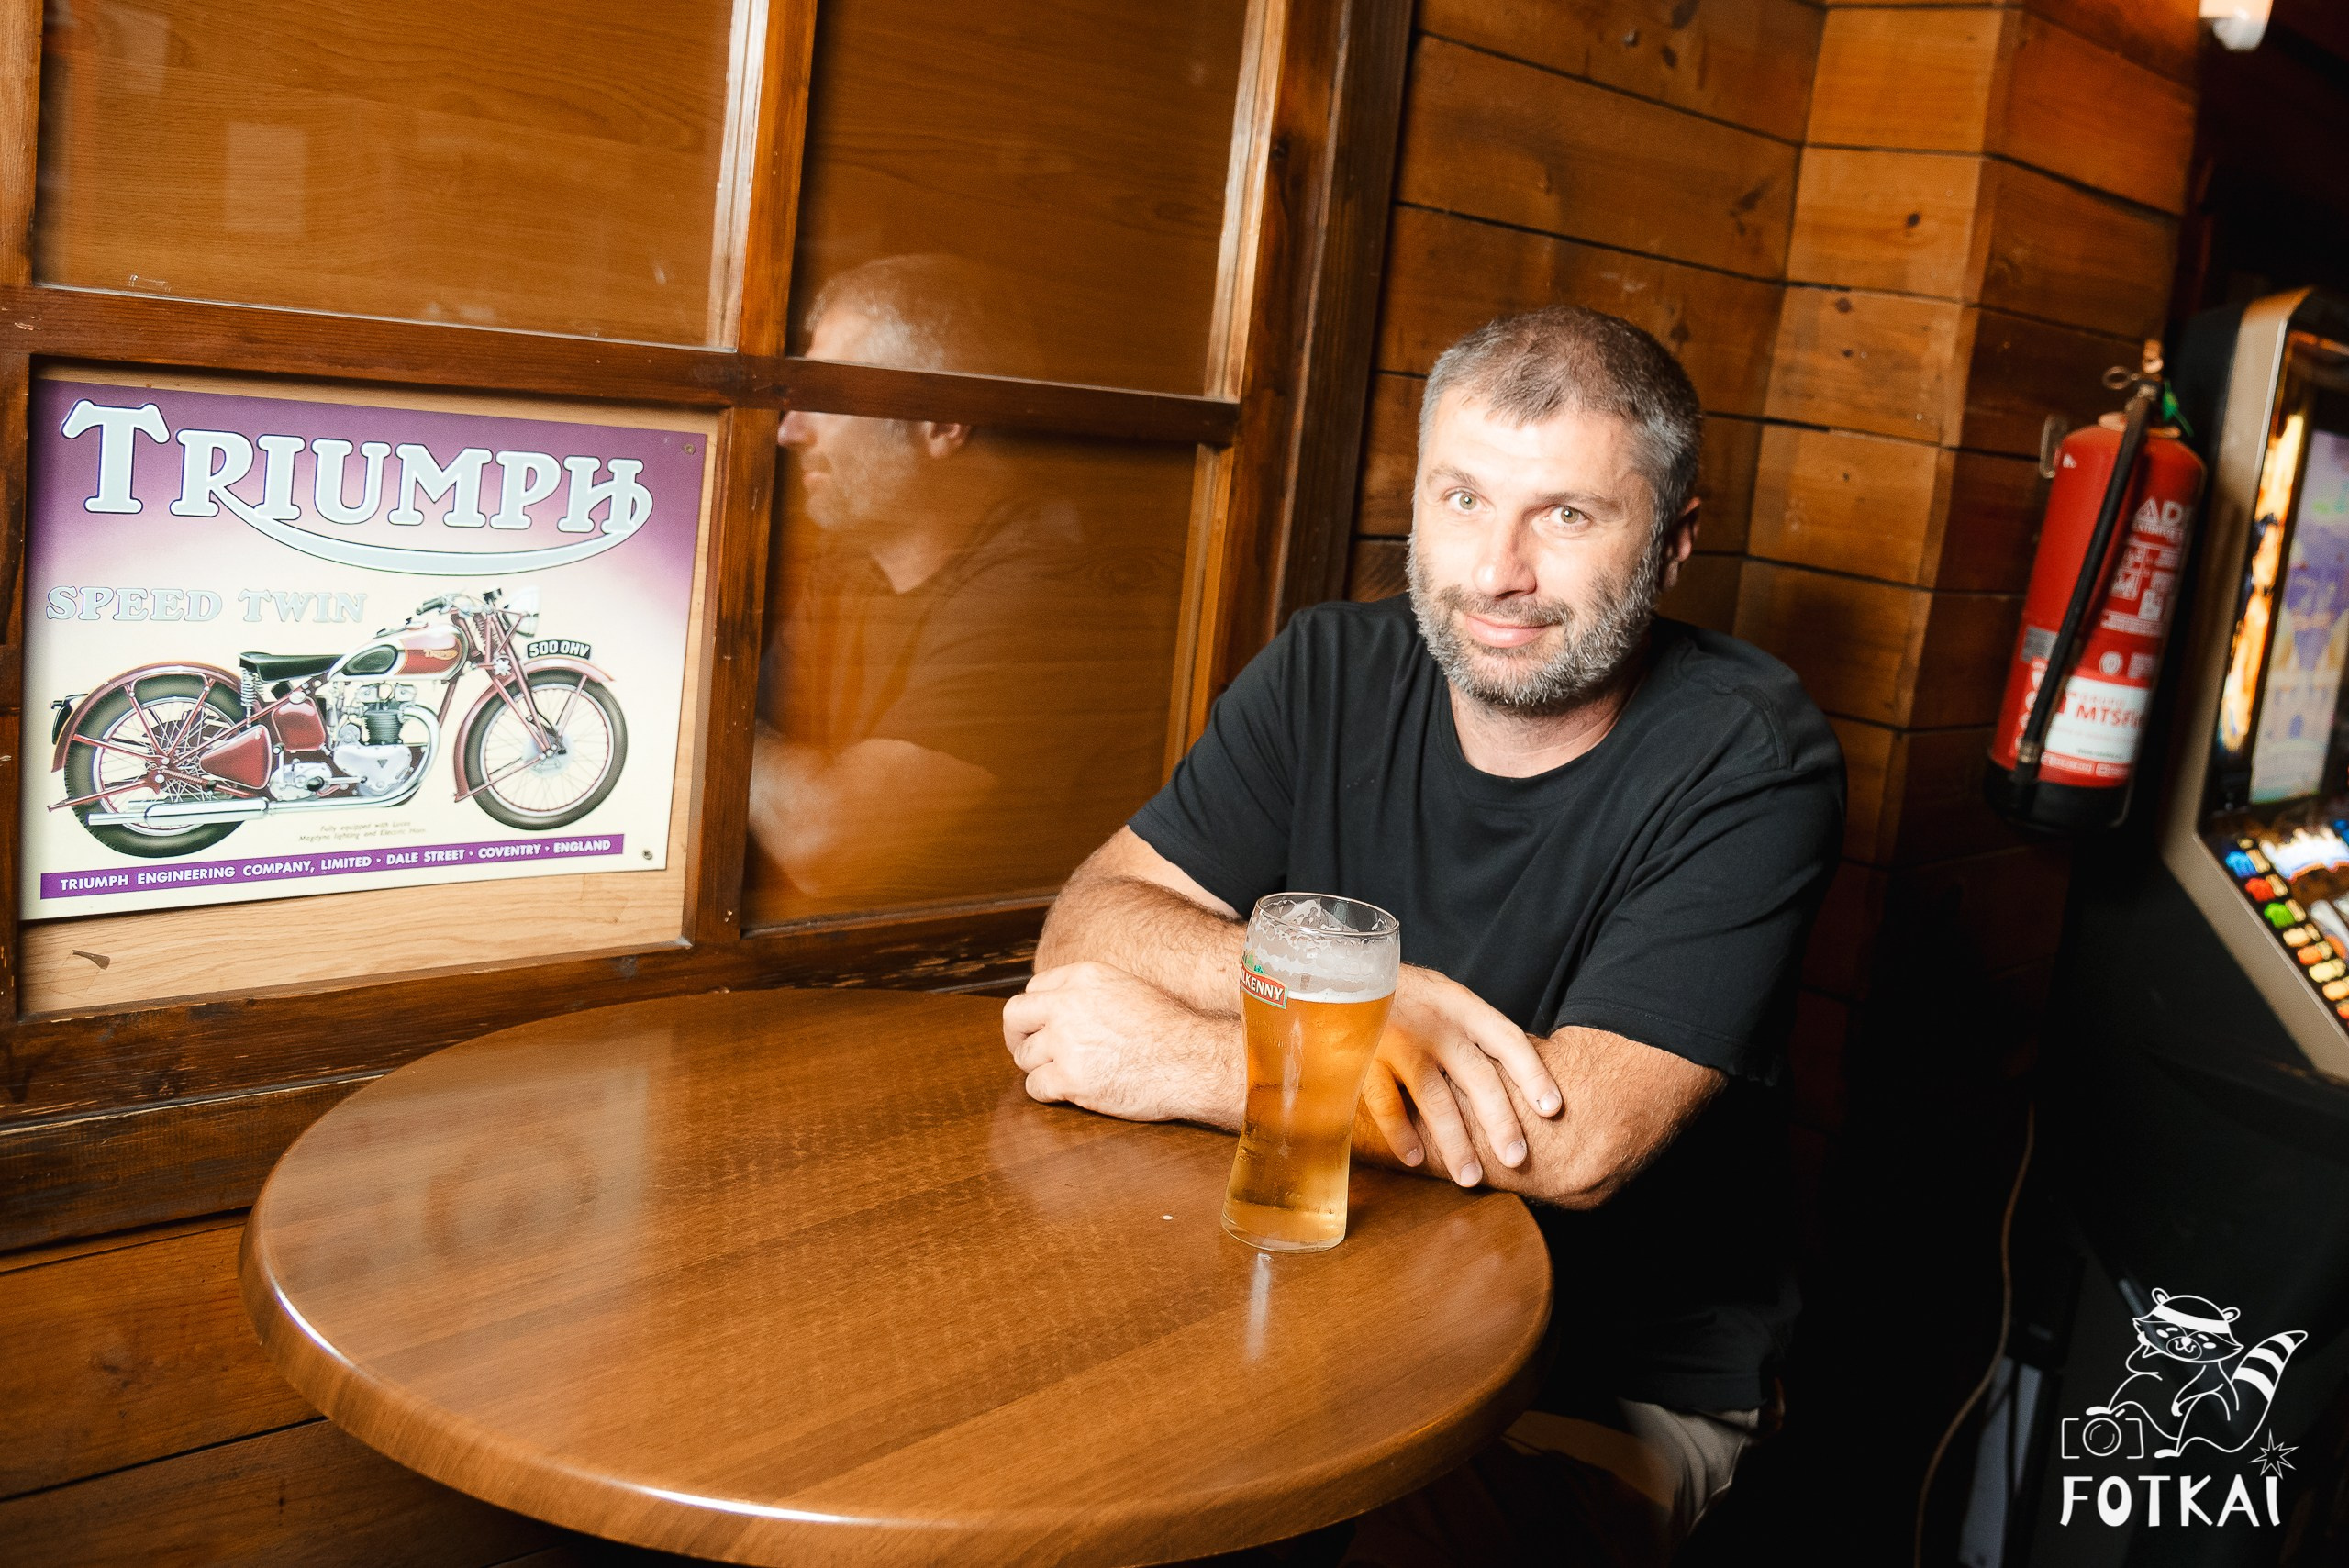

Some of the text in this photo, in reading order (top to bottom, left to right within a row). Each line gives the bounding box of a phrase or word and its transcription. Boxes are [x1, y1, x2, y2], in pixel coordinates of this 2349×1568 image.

[61, 398, 654, 576] TRIUMPH
[46, 586, 368, 623] SPEED TWIN
[560, 640, 590, 657] OHV
[61, 840, 611, 891] TRIUMPH ENGINEERING COMPANY, LIMITED DALE STREET COVENTRY ENGLAND
